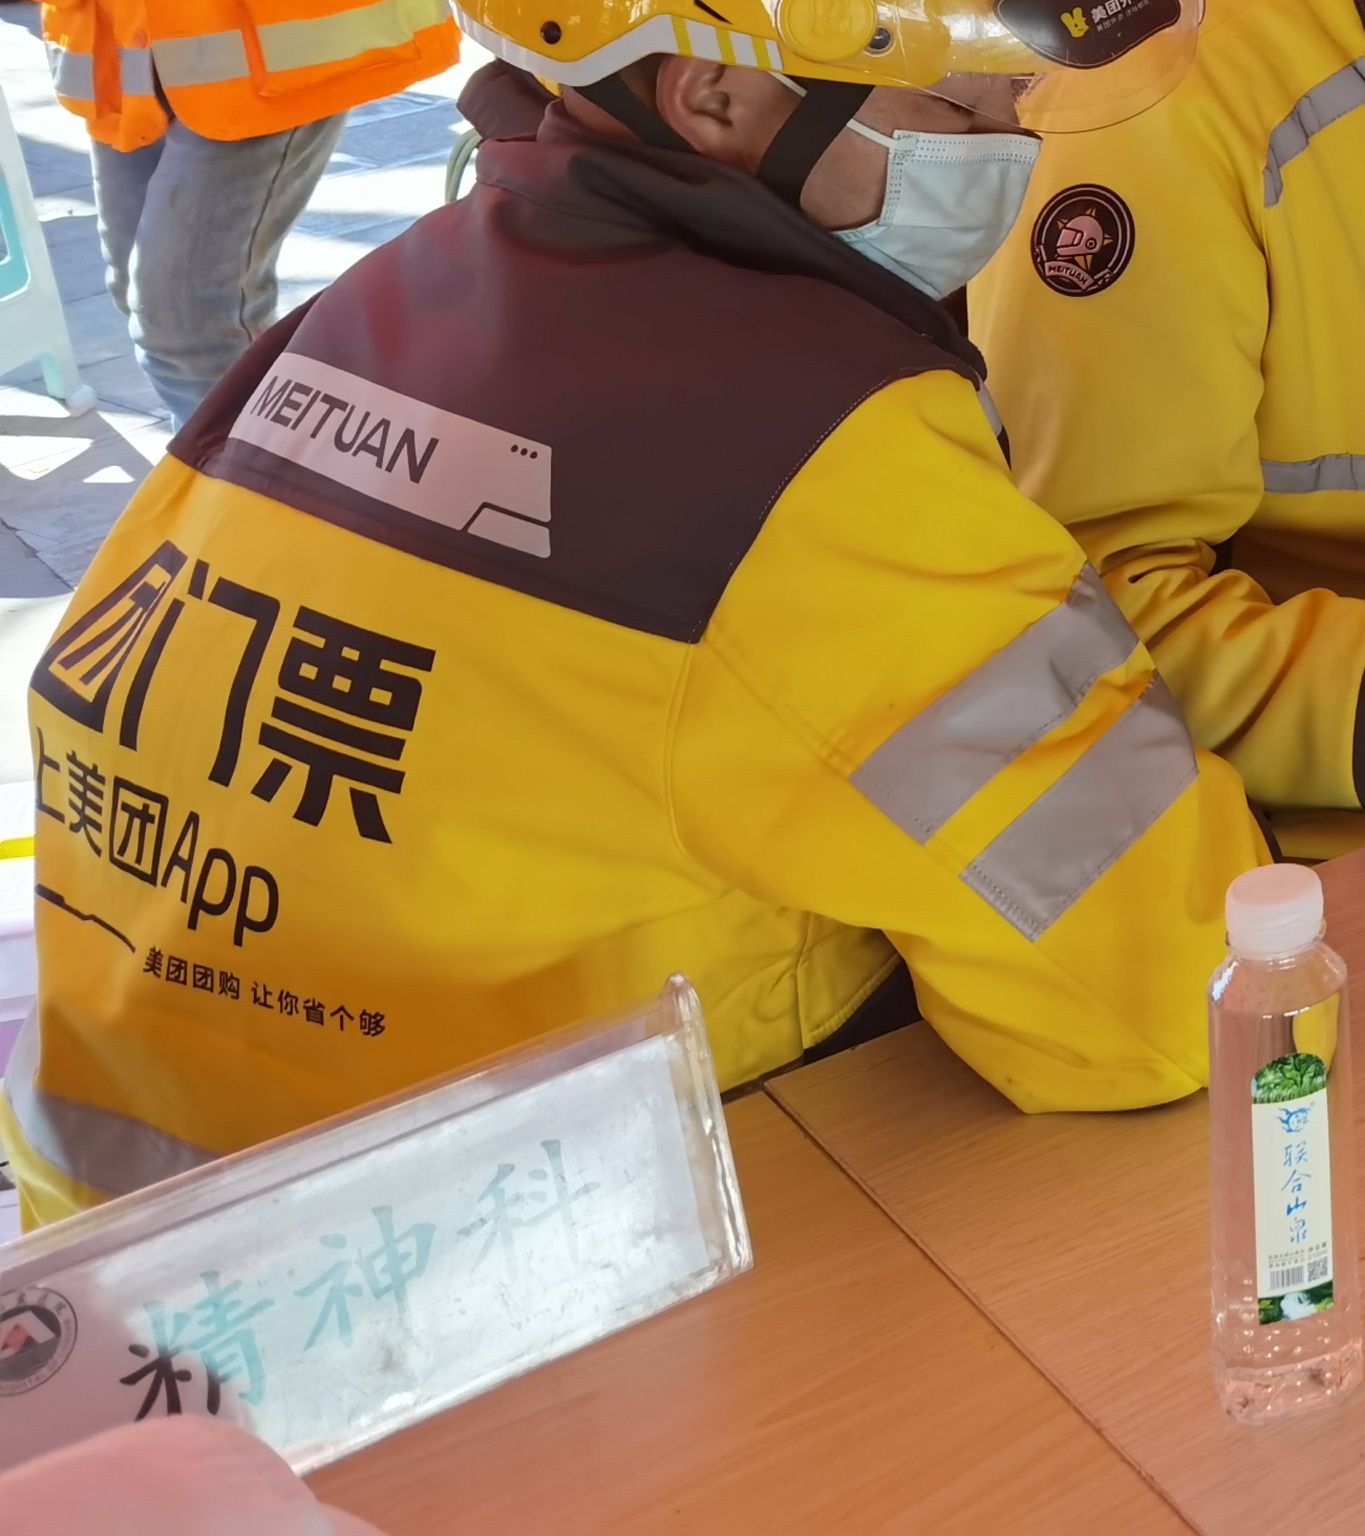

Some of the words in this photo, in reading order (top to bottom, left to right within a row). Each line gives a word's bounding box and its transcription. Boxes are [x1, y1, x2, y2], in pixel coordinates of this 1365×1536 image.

[1047, 265, 1088, 285] MEITUAN
[251, 374, 440, 485] MEITUAN
[29, 539, 437, 845] 团门票
[143, 944, 241, 1000] 美团团购
[251, 980, 387, 1040] 让你省个够
[1280, 1140, 1312, 1243] 联合山泉
[119, 1137, 602, 1424] 精神科
